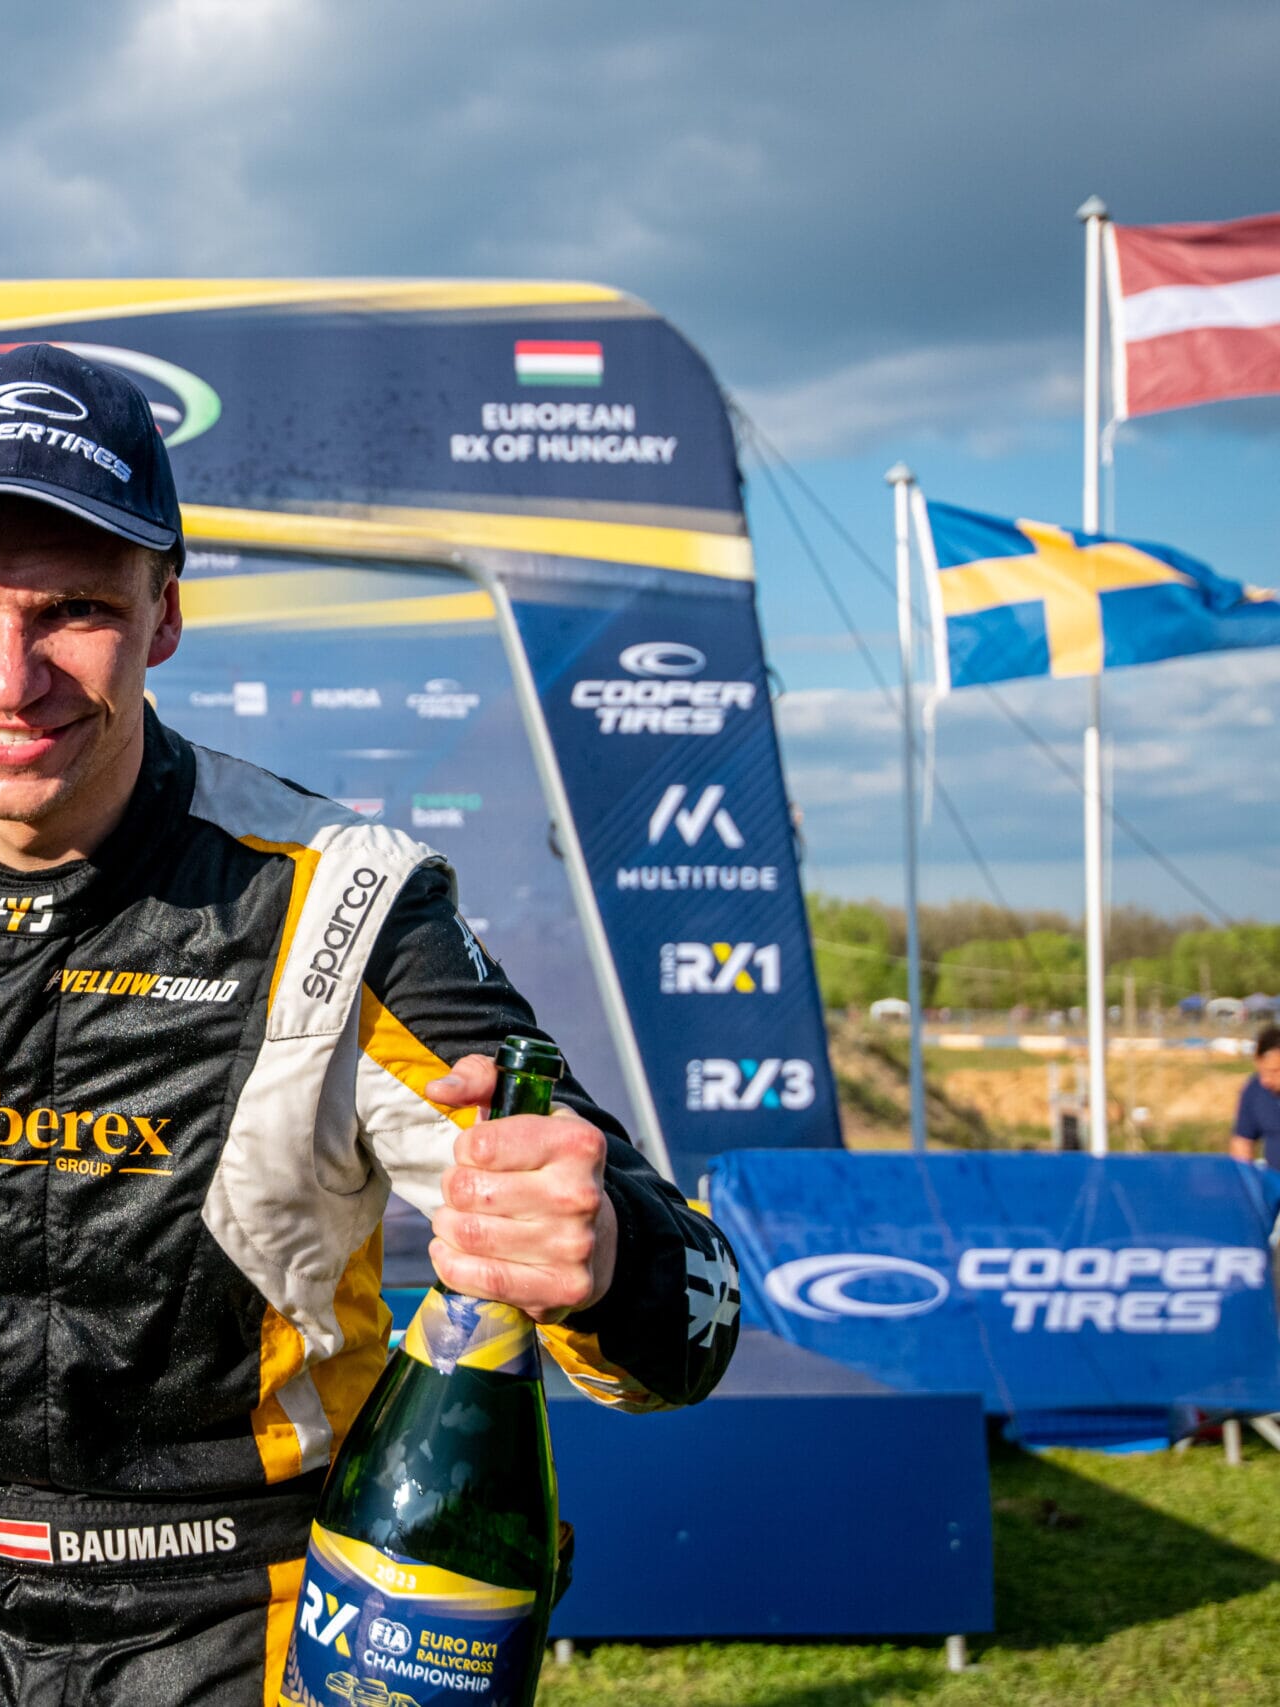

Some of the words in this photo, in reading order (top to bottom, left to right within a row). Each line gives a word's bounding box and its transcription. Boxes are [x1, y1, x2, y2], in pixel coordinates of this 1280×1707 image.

[481, 402, 635, 431] EUROPEAN
[450, 434, 490, 462] RX
[493, 434, 534, 462] OF
[538, 435, 678, 464] HUNGARY
[571, 680, 756, 710] COOPER
[595, 706, 725, 735] TIRES
[617, 866, 778, 890] MULTITUDE
[302, 868, 388, 1005] sparco
[676, 942, 780, 994] RX1
[702, 1058, 815, 1111] RX3
[56, 1157, 111, 1177] GROUP
[957, 1246, 1267, 1289] COOPER
[1003, 1291, 1223, 1333] TIRES
[58, 1517, 237, 1563] BAUMANIS
[375, 1563, 417, 1590] 2023
[299, 1579, 360, 1658] RX
[419, 1630, 469, 1655] EURO
[470, 1640, 498, 1660] RX1
[363, 1649, 490, 1693] CHAMPIONSHIP
[415, 1648, 494, 1675] RALLYCROSS
